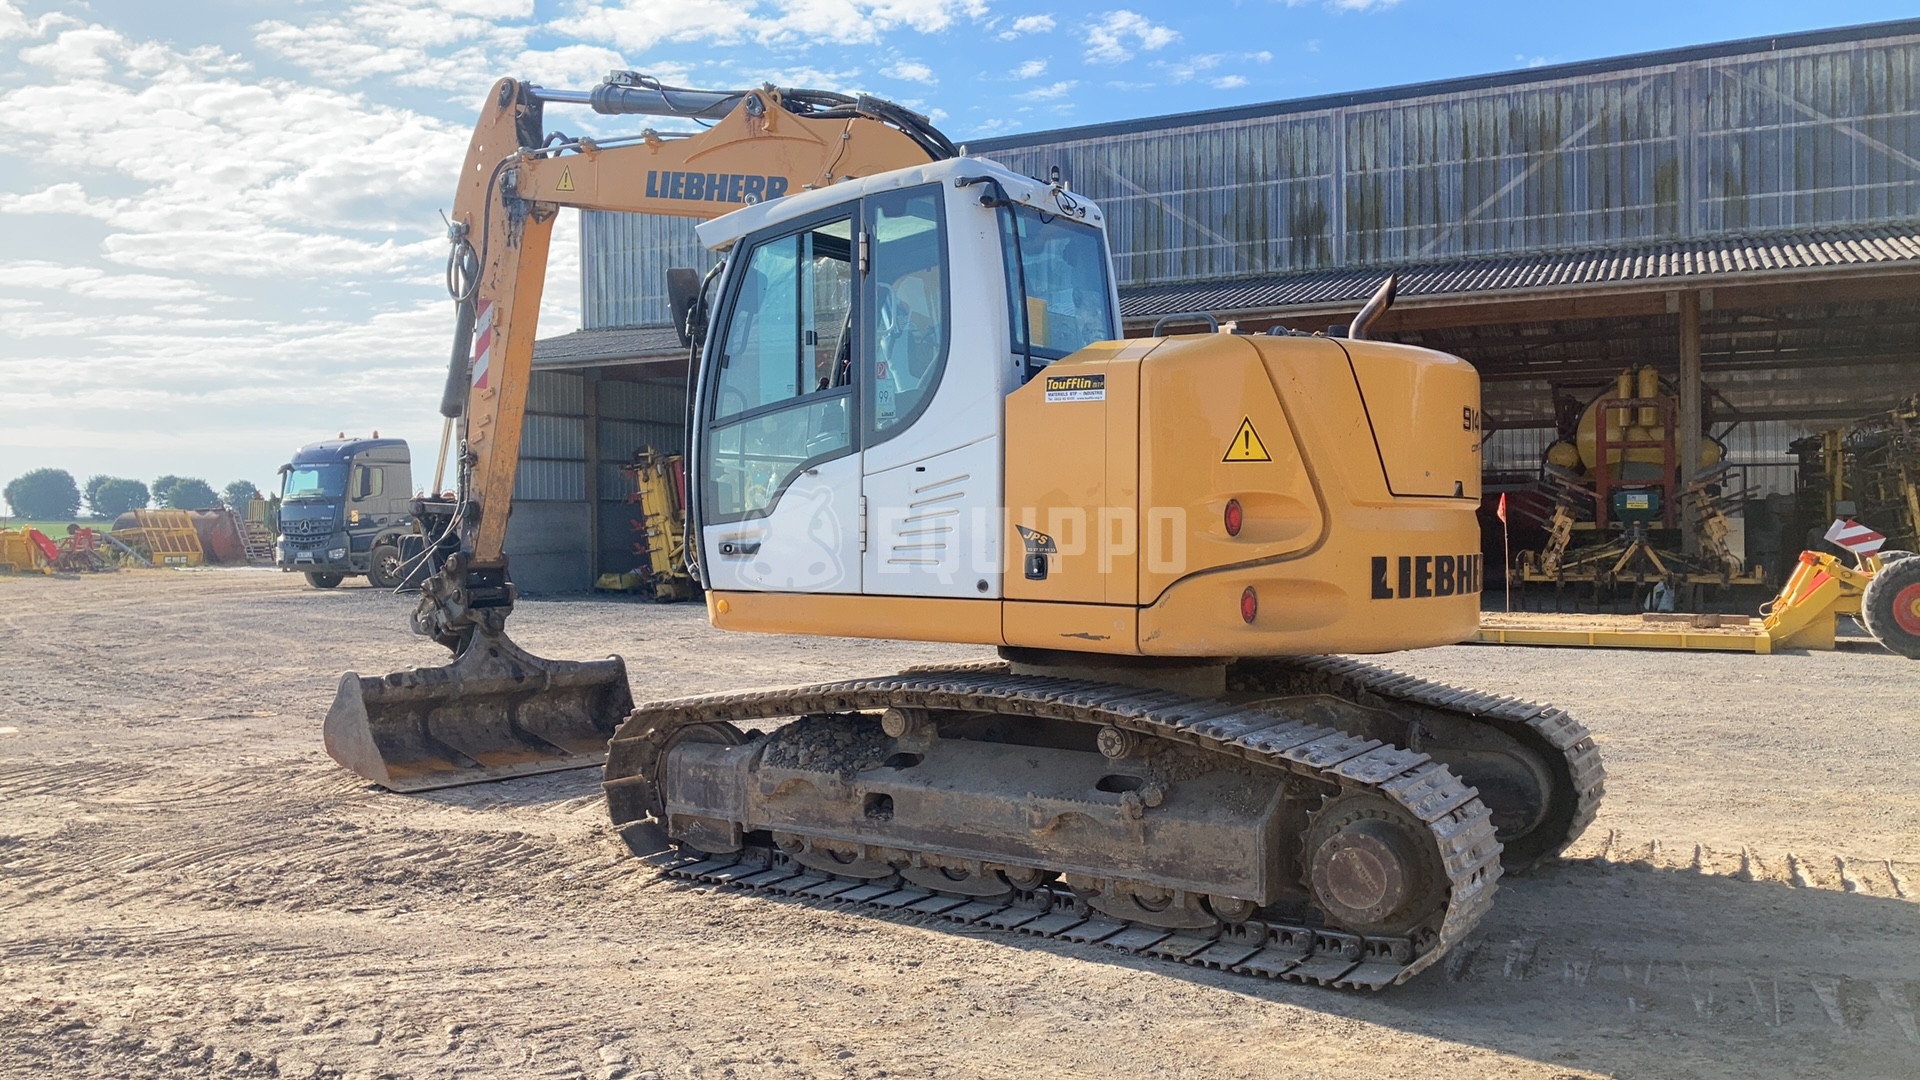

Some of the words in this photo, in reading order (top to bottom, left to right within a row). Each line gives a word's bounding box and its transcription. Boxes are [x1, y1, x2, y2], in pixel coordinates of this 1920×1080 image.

[645, 170, 789, 203] LIEBHERR
[1047, 378, 1091, 389] Toufflin
[879, 390, 888, 402] 99
[1023, 531, 1048, 544] JPS
